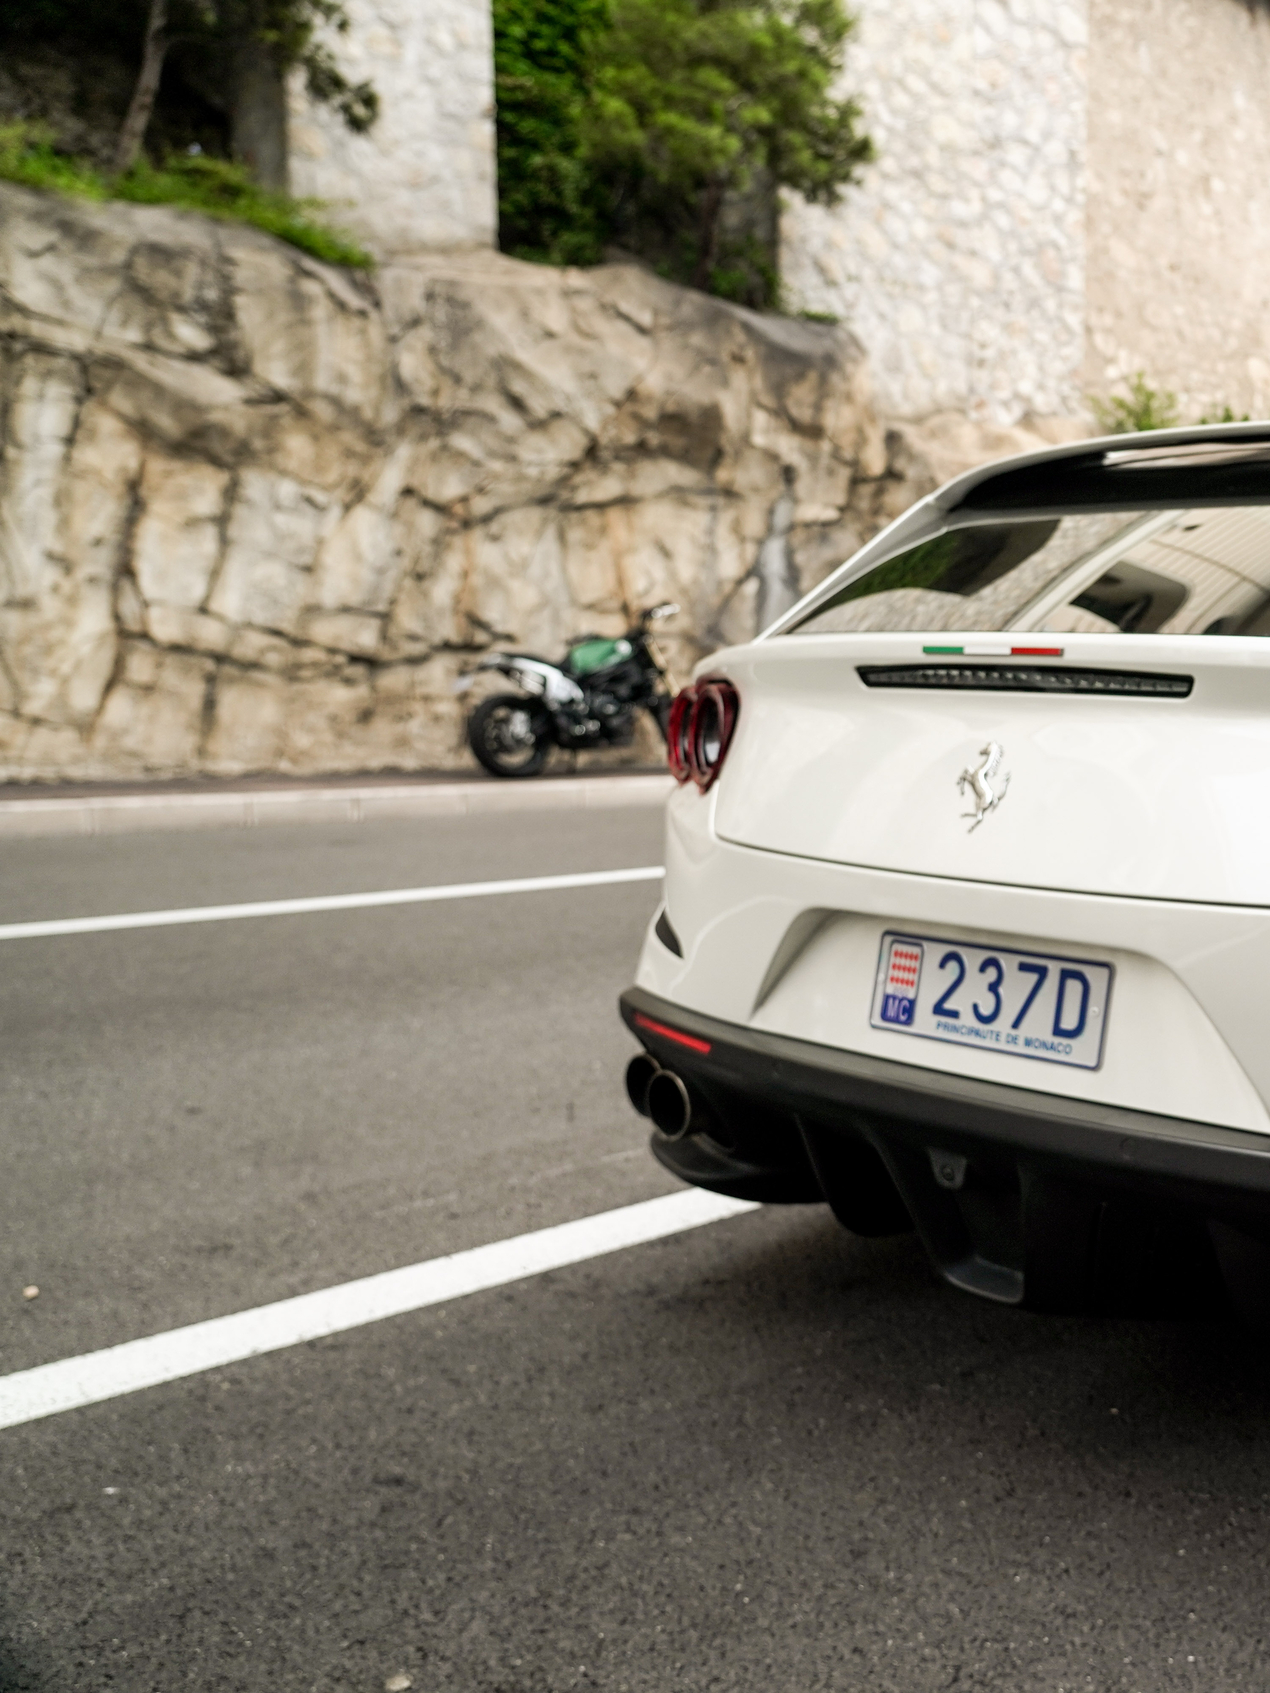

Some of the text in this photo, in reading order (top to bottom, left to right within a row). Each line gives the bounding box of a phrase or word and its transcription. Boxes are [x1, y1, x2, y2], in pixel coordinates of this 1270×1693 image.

[887, 996, 910, 1020] MC
[932, 950, 1091, 1040] 237D
[936, 1020, 1073, 1055] PRINCIPAUTE DE MONACO
